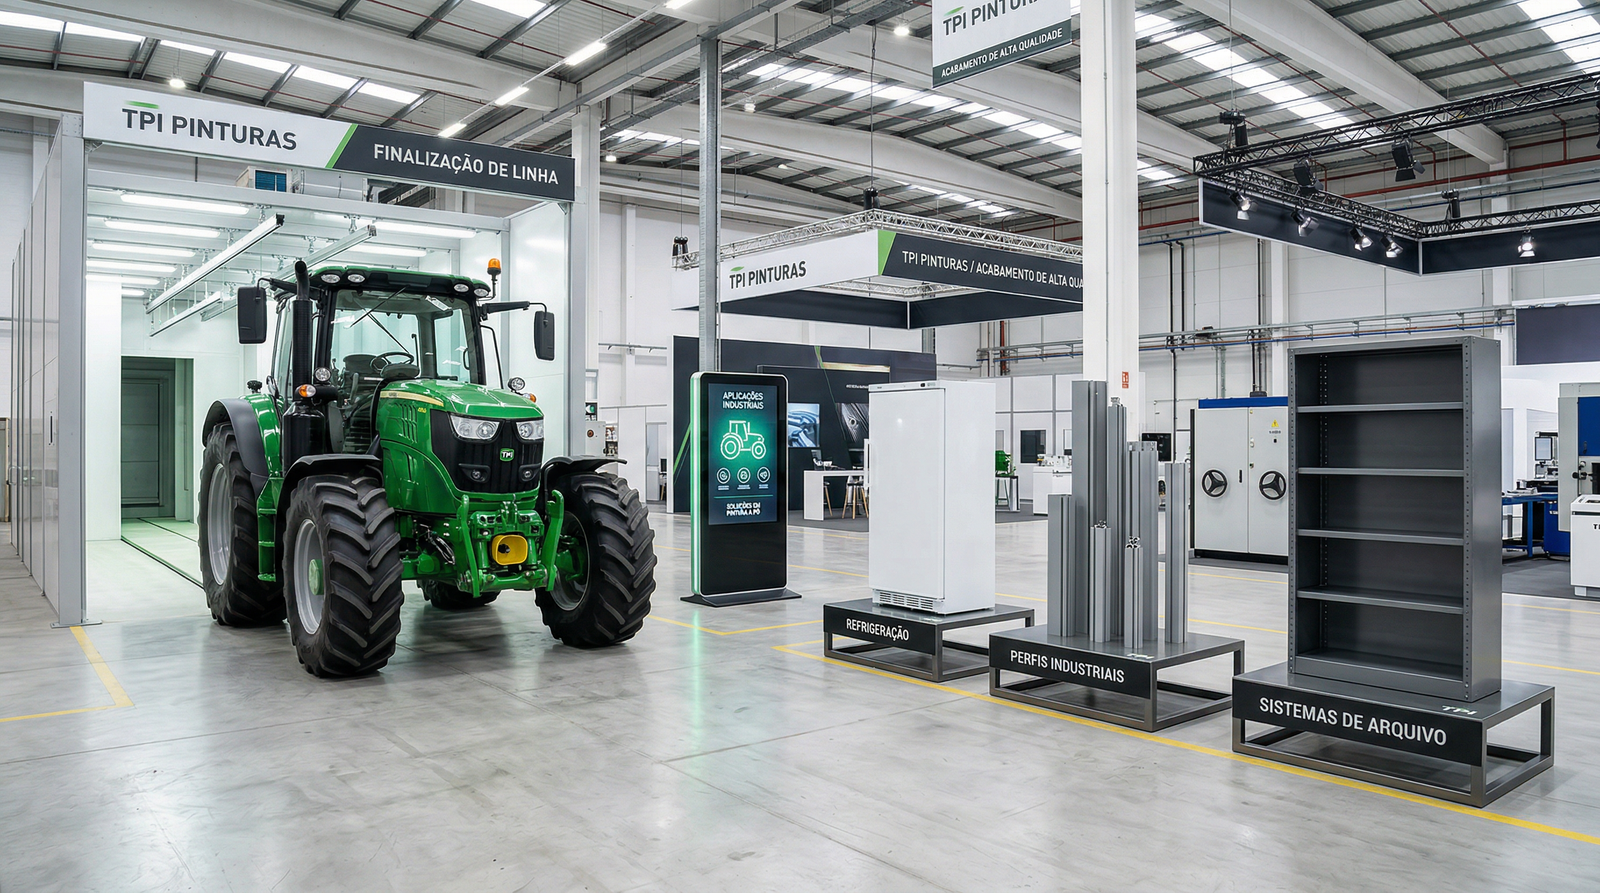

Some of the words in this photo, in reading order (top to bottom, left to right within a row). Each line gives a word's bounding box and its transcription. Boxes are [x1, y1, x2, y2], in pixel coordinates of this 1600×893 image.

[943, 12, 966, 36] TPI
[942, 55, 988, 78] ACABAMENTO
[988, 50, 999, 62] DE
[1000, 45, 1018, 57] ALTA
[1019, 28, 1063, 51] QUALIDADE
[122, 108, 162, 132] TPI
[172, 115, 297, 150] PINTURAS
[374, 144, 484, 174] FINALIZAÇÃO
[488, 161, 508, 177] DE
[512, 164, 559, 184] LINHA
[730, 273, 746, 289] TPI
[748, 260, 806, 286] PINTURAS
[902, 251, 918, 265] TPI
[920, 254, 968, 272] PINTURAS
[970, 261, 974, 273] /
[976, 262, 1034, 282] ACABAMENTO
[1036, 272, 1047, 283] DE
[1048, 273, 1067, 287] ALTA
[722, 391, 763, 402] APLICAÇÕES
[722, 401, 764, 409] INDUSTRIAIS
[846, 618, 909, 641] REFRIGERAÇÃO
[1010, 650, 1048, 668] PERFIS
[1051, 657, 1125, 683] INDUSTRIAIS
[1259, 697, 1338, 725] SISTEMAS
[1342, 712, 1364, 731] DE
[1368, 717, 1447, 746] ARQUIVO
